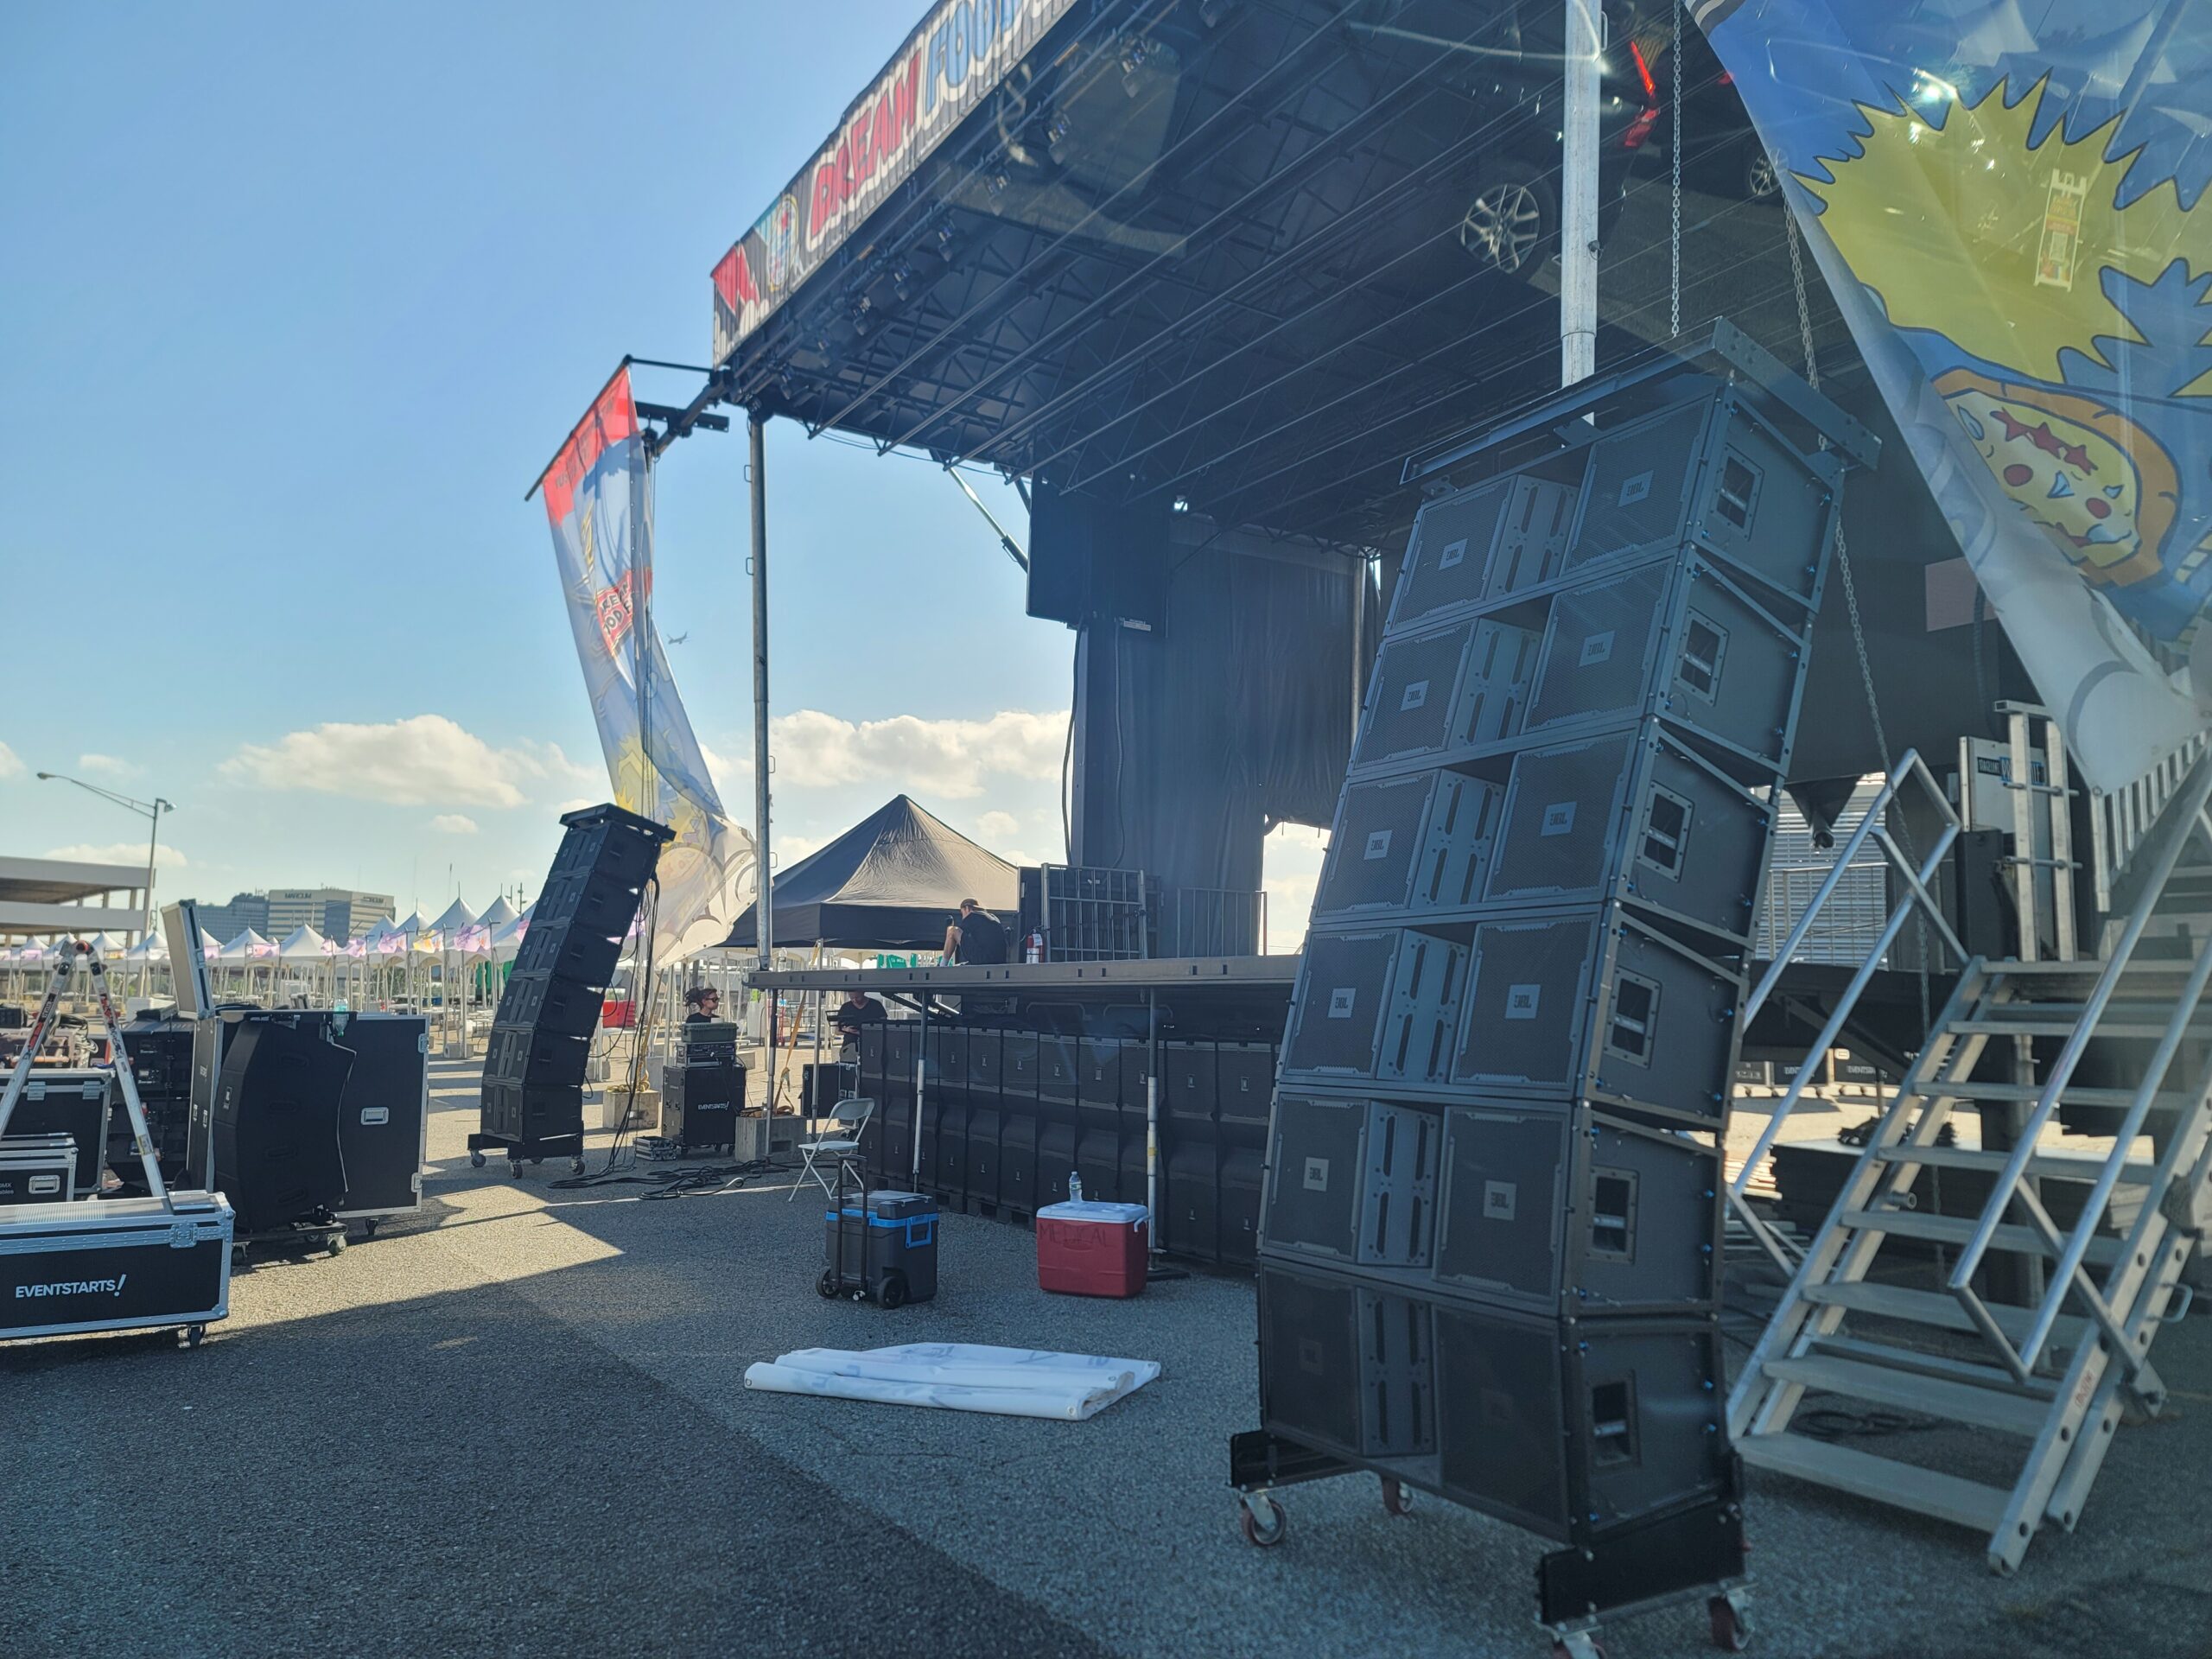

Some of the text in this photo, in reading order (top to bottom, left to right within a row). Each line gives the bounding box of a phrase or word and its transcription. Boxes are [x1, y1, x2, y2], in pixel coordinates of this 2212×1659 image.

[810, 45, 922, 238] DREAM
[1626, 480, 1645, 497] JBL
[1445, 547, 1460, 560] JBL
[1587, 642, 1605, 657] JBL
[1407, 689, 1421, 702] JBL
[1548, 811, 1567, 827] JBL
[1370, 838, 1385, 851] JBL
[1334, 996, 1349, 1009] JBL
[1513, 994, 1532, 1009] JBL
[1039, 1222, 1118, 1249] MEDICAL
[16, 1274, 127, 1298] EVENTSTARTS!
